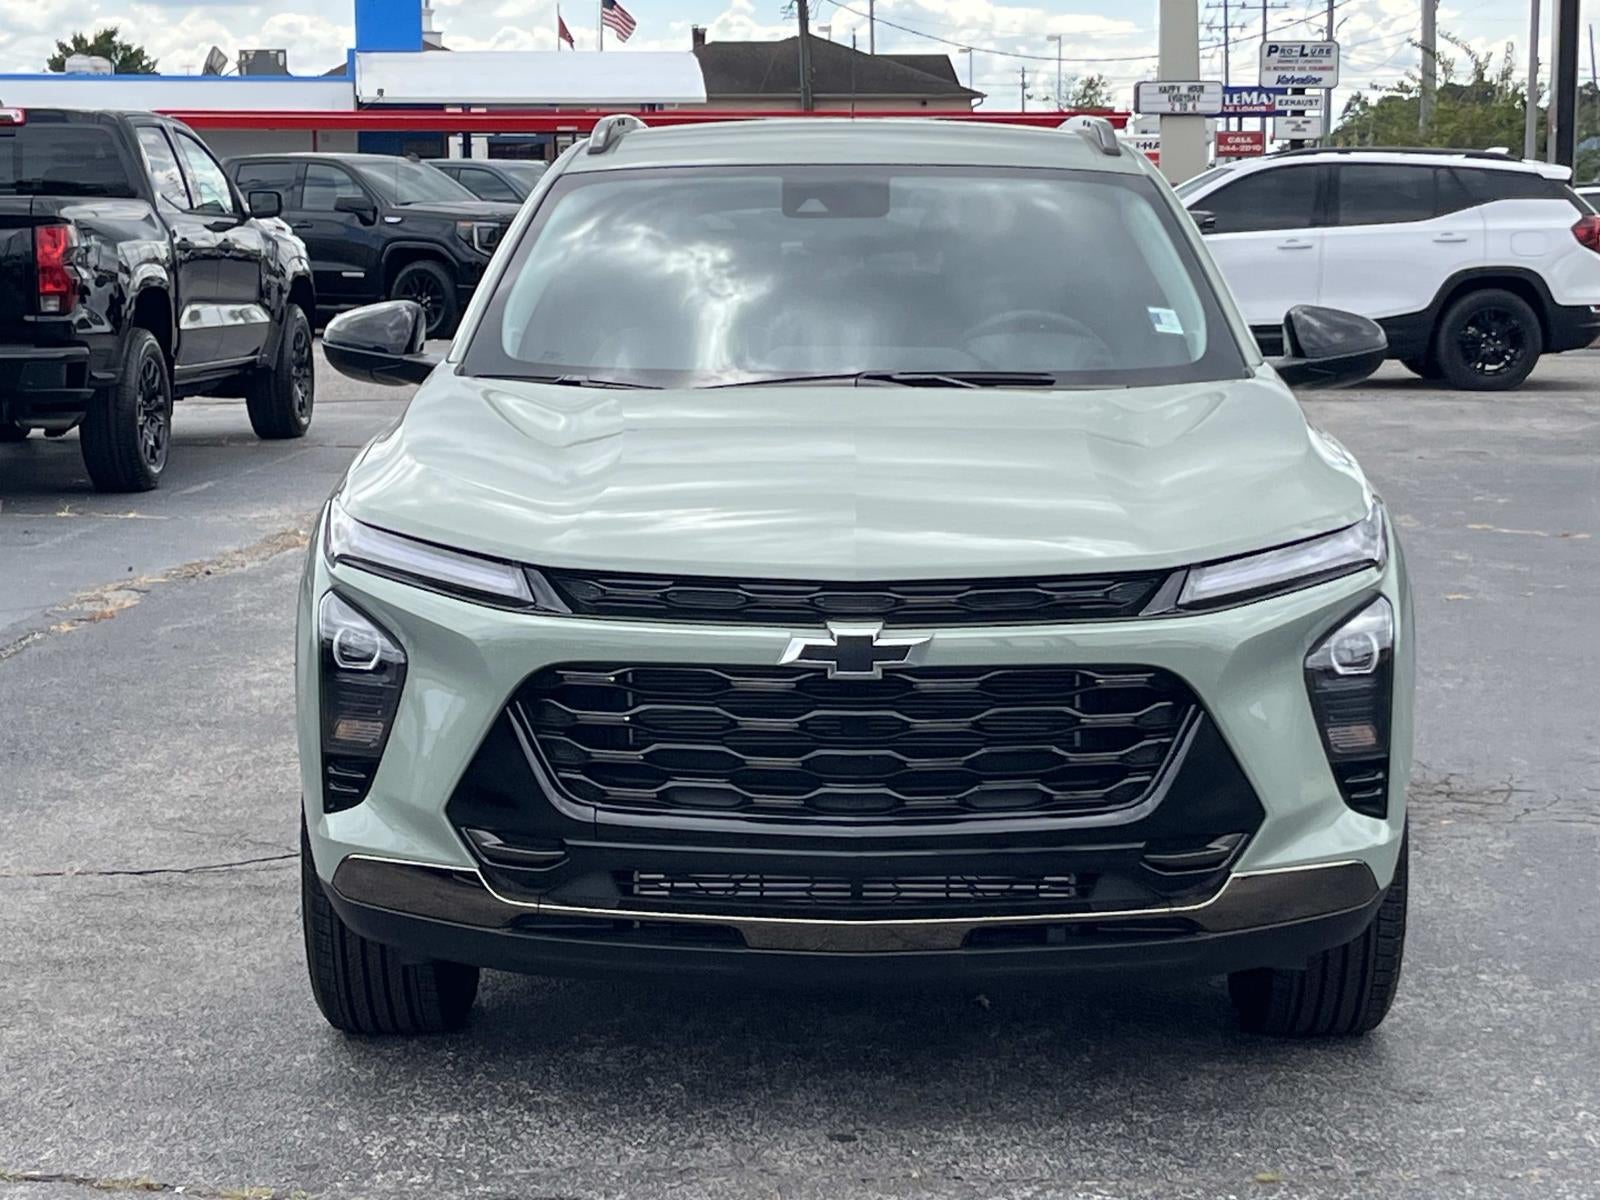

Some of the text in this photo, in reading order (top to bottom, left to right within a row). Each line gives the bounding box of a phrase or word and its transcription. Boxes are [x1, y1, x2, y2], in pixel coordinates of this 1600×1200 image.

[1158, 85, 1181, 94] HAPPY
[1278, 98, 1320, 107] EXHAUST
[1227, 136, 1253, 144] CALL
